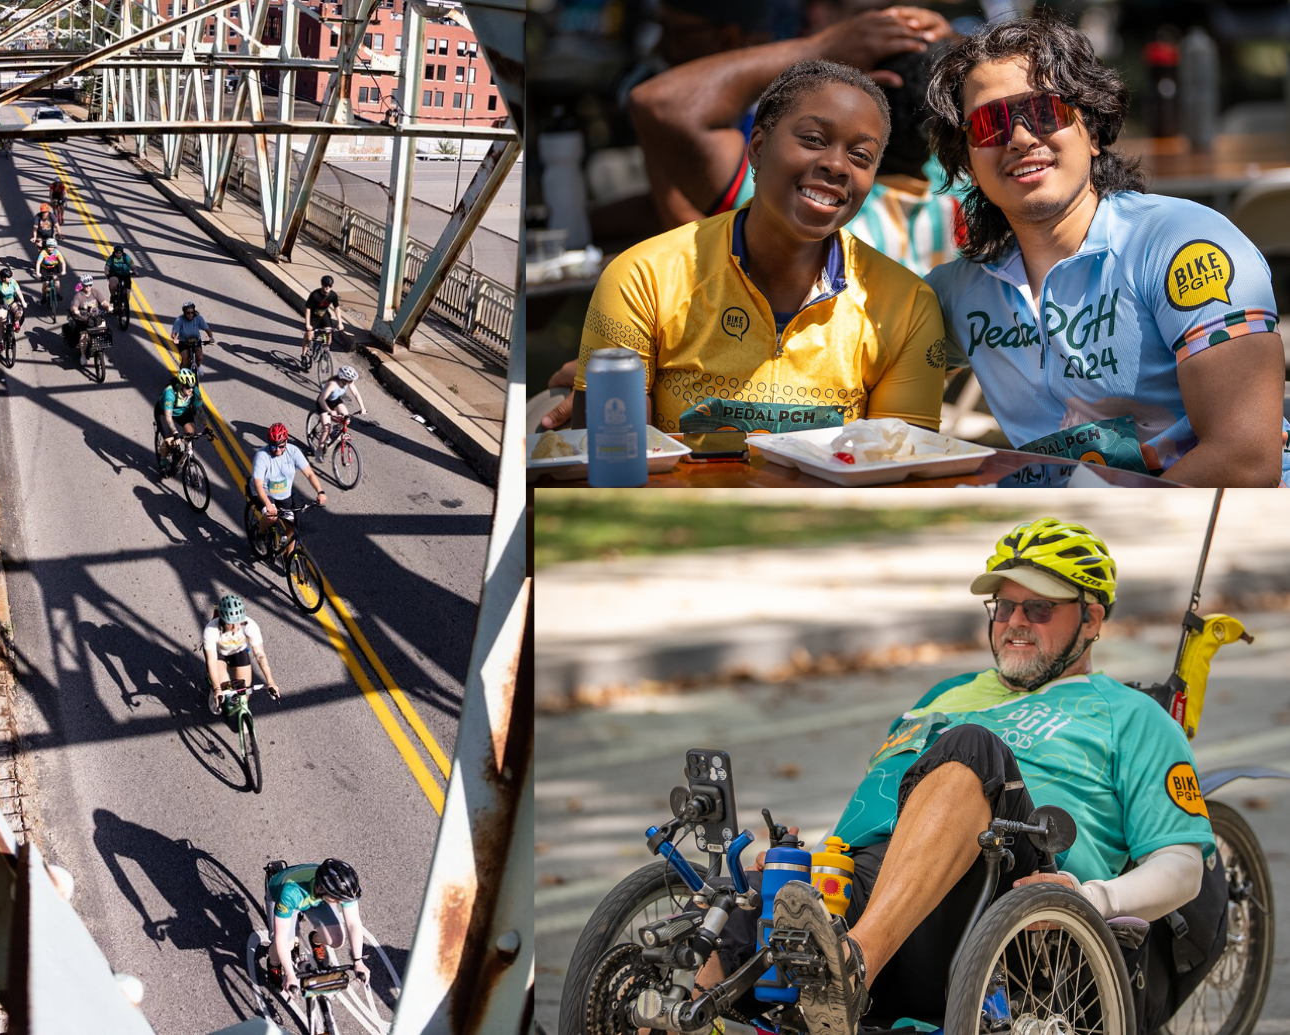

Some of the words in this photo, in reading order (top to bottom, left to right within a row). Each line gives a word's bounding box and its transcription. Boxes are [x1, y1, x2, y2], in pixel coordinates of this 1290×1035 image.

[1174, 252, 1221, 287] BIKE
[1178, 269, 1224, 299] PGH!
[727, 314, 744, 323] BIKE
[1062, 346, 1118, 380] 2024
[722, 406, 775, 422] PEDAL
[778, 410, 816, 424] PGH
[1033, 440, 1064, 456] EDAL
[1064, 428, 1101, 449] PGH
[1070, 572, 1102, 588] LAZER
[1000, 728, 1034, 749] 2025
[1172, 776, 1200, 791] BIK
